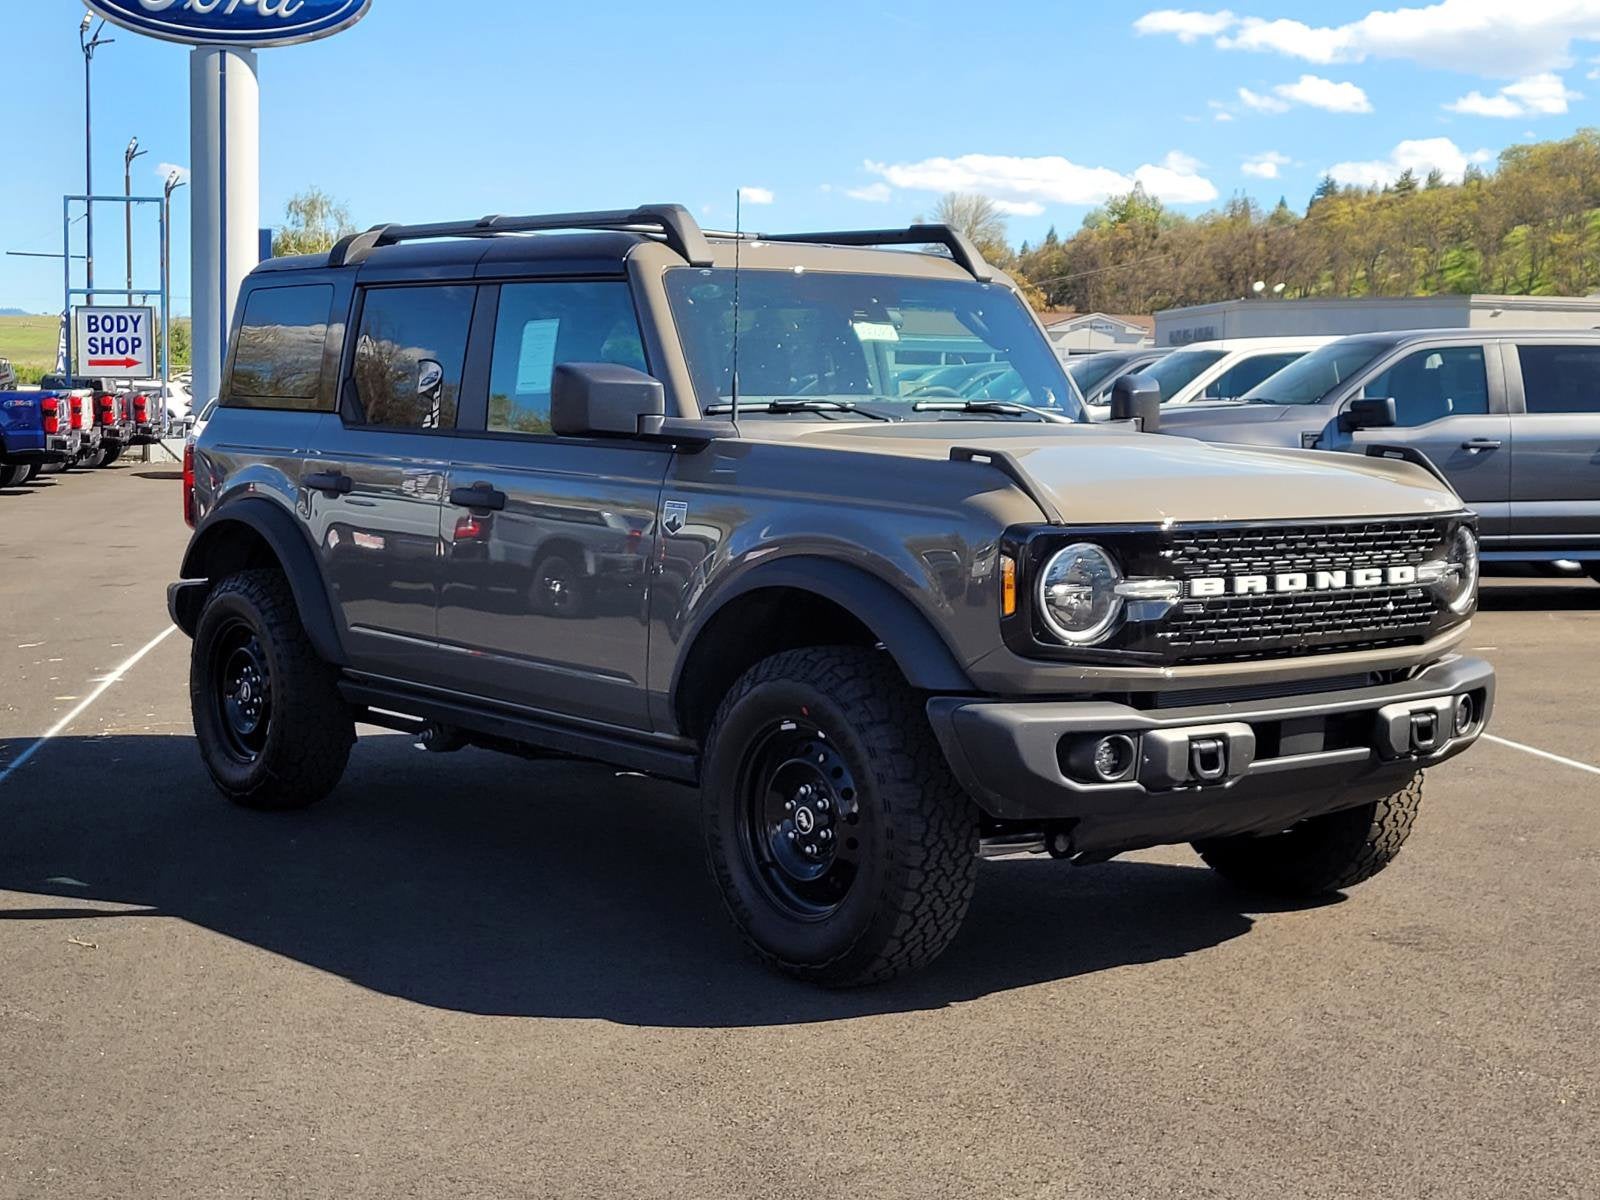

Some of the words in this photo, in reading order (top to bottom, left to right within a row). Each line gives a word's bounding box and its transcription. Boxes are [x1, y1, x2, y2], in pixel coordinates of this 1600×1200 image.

[87, 314, 142, 333] BODY
[87, 336, 142, 355] SHOP
[1190, 566, 1416, 597] BRONCO
